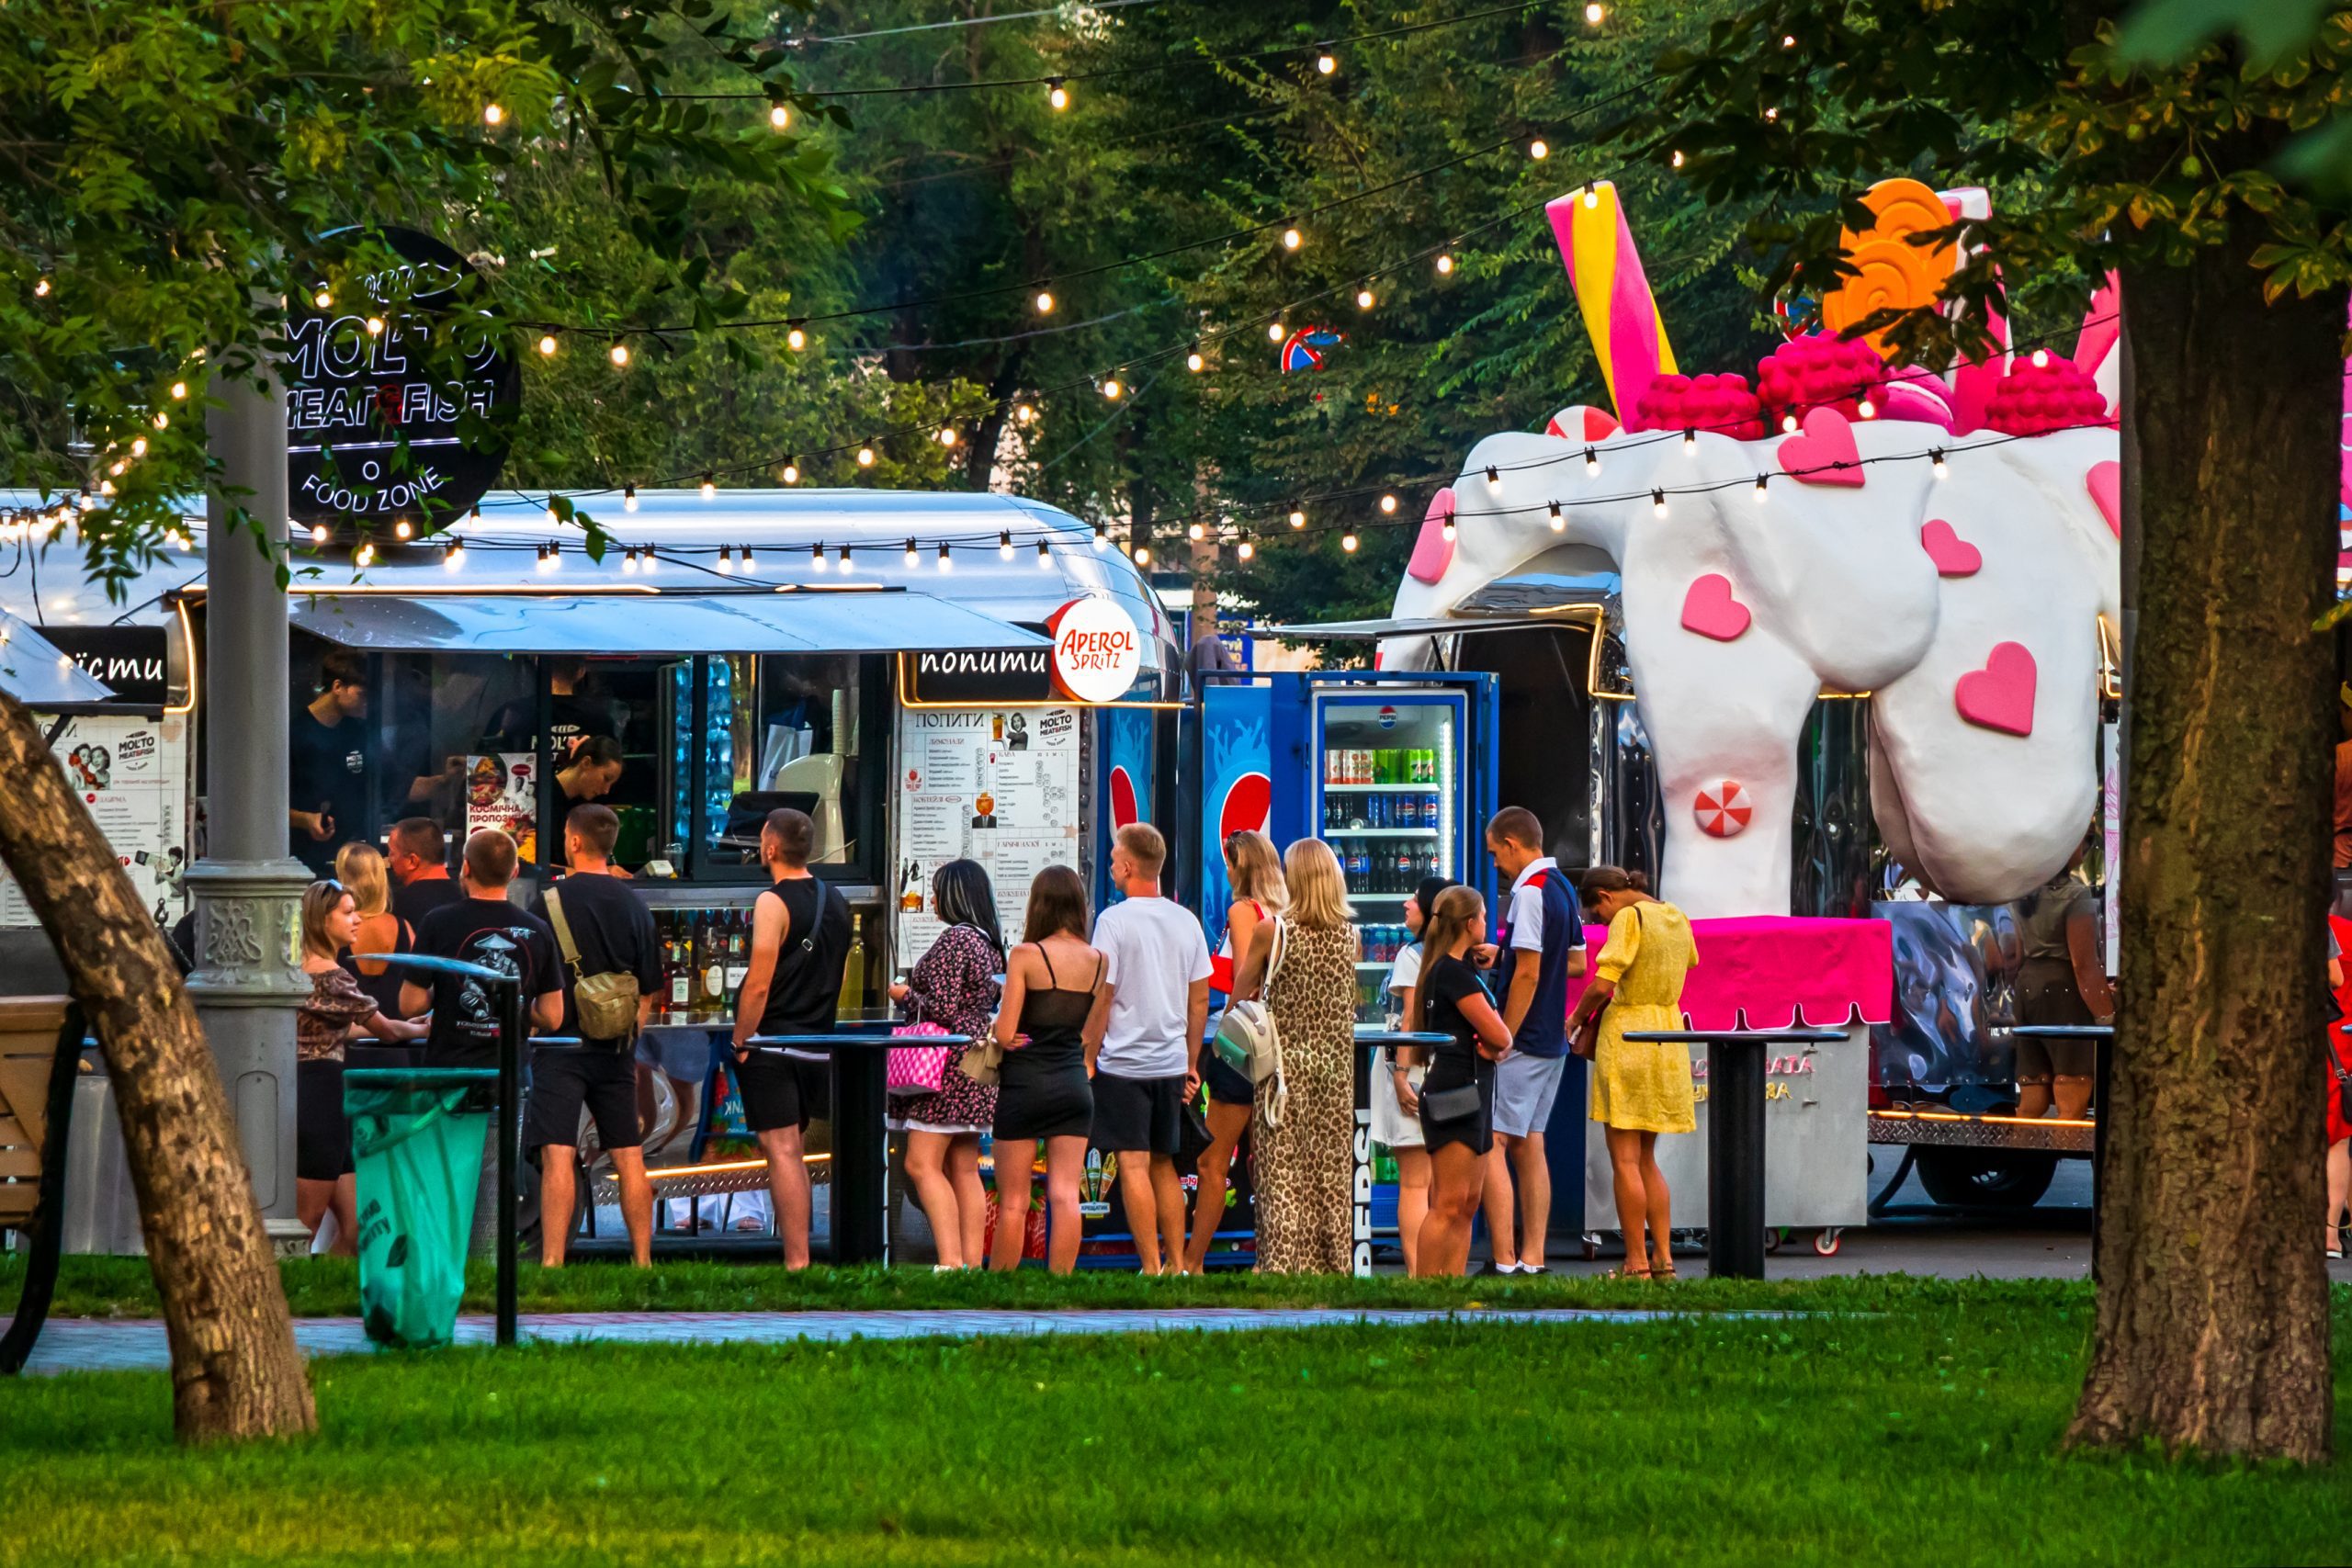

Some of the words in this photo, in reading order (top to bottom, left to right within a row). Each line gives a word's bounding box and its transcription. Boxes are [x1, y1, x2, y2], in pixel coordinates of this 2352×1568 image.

[301, 474, 369, 512] FOOD
[376, 467, 444, 512] ZONE
[1059, 628, 1135, 655] APEROL
[921, 650, 1046, 673] попити
[916, 713, 985, 728] ПОПИТИ
[469, 804, 521, 813] КОСМІЧНА
